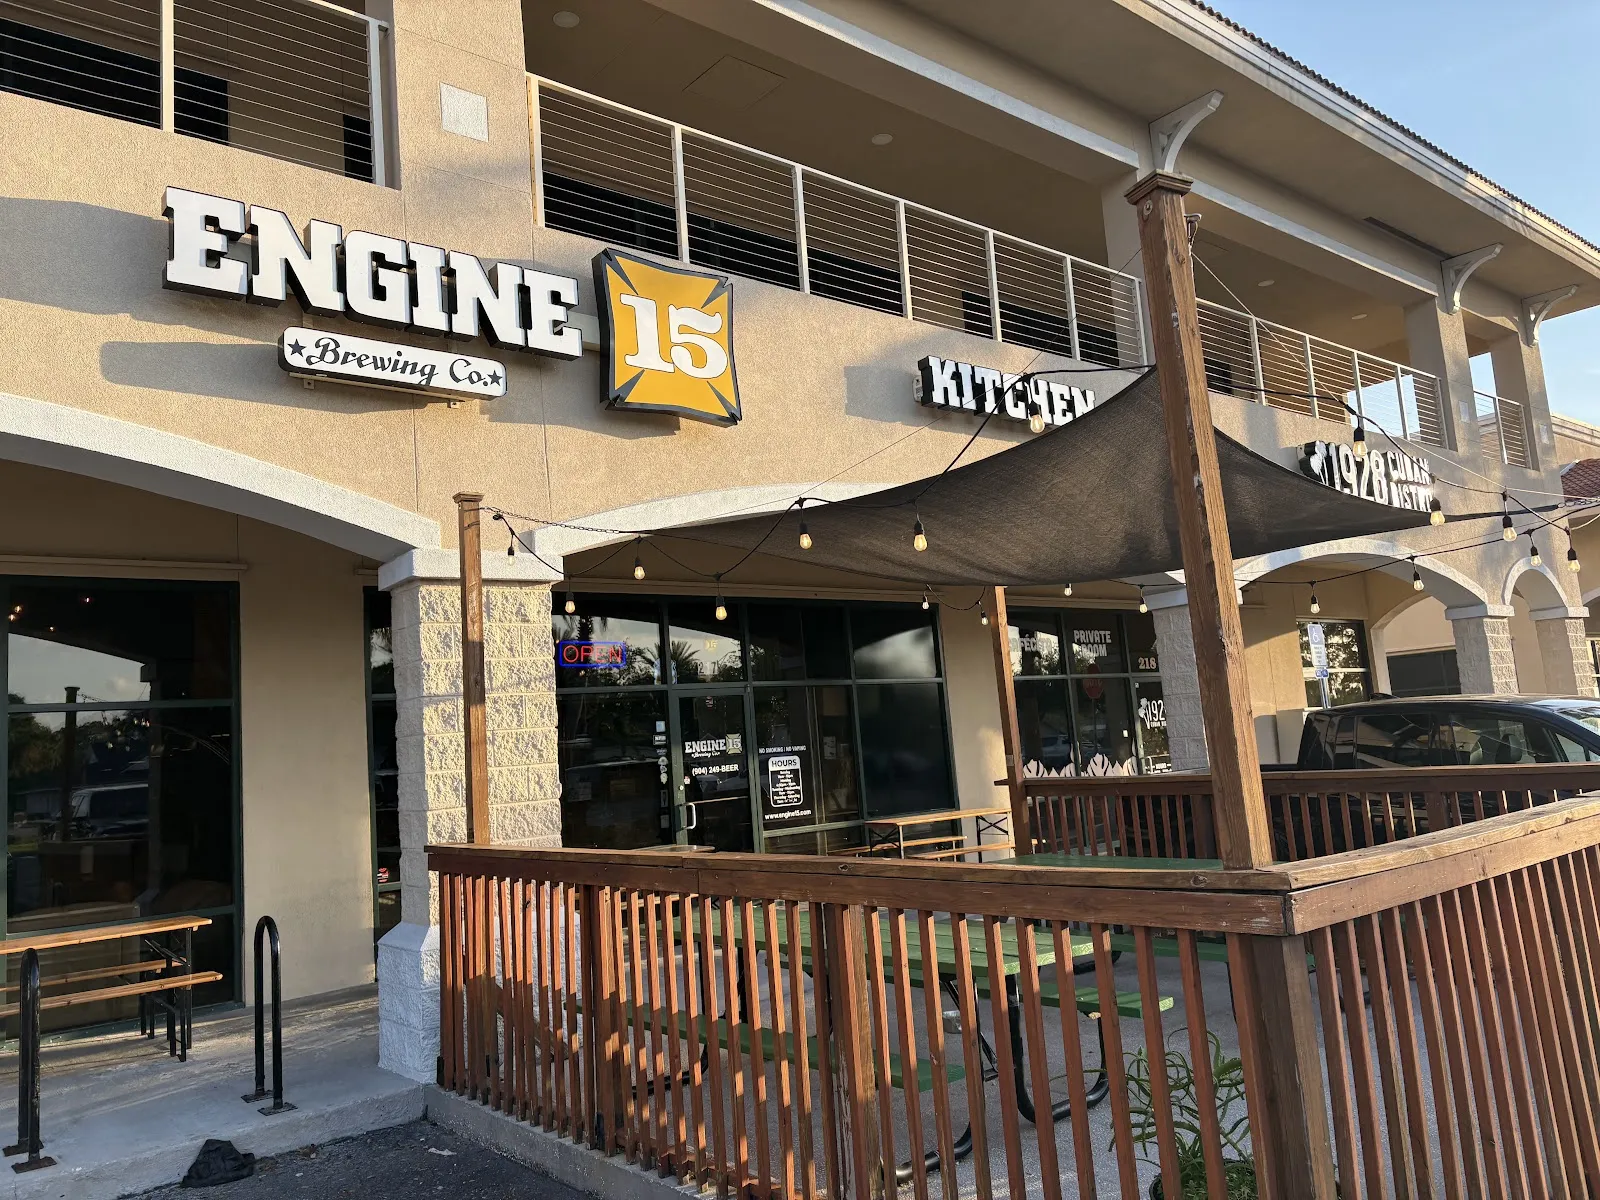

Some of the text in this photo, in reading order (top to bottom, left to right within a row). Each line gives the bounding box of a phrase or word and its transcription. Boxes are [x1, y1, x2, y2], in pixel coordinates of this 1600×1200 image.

[164, 187, 582, 357] ENGINE
[619, 293, 728, 379] 15
[305, 336, 488, 387] Brewing Co.
[926, 355, 1096, 426] KITCHEN
[1328, 442, 1388, 505] 1928
[1073, 630, 1112, 643] PRIVATE
[562, 645, 622, 663] OPEN
[1081, 643, 1107, 657] ROOM
[1138, 656, 1157, 670] 218
[1148, 699, 1167, 721] 192
[685, 739, 741, 753] ENGINE 15
[692, 764, 739, 776] (904) 249-BEER
[771, 759, 797, 768] HOURS
